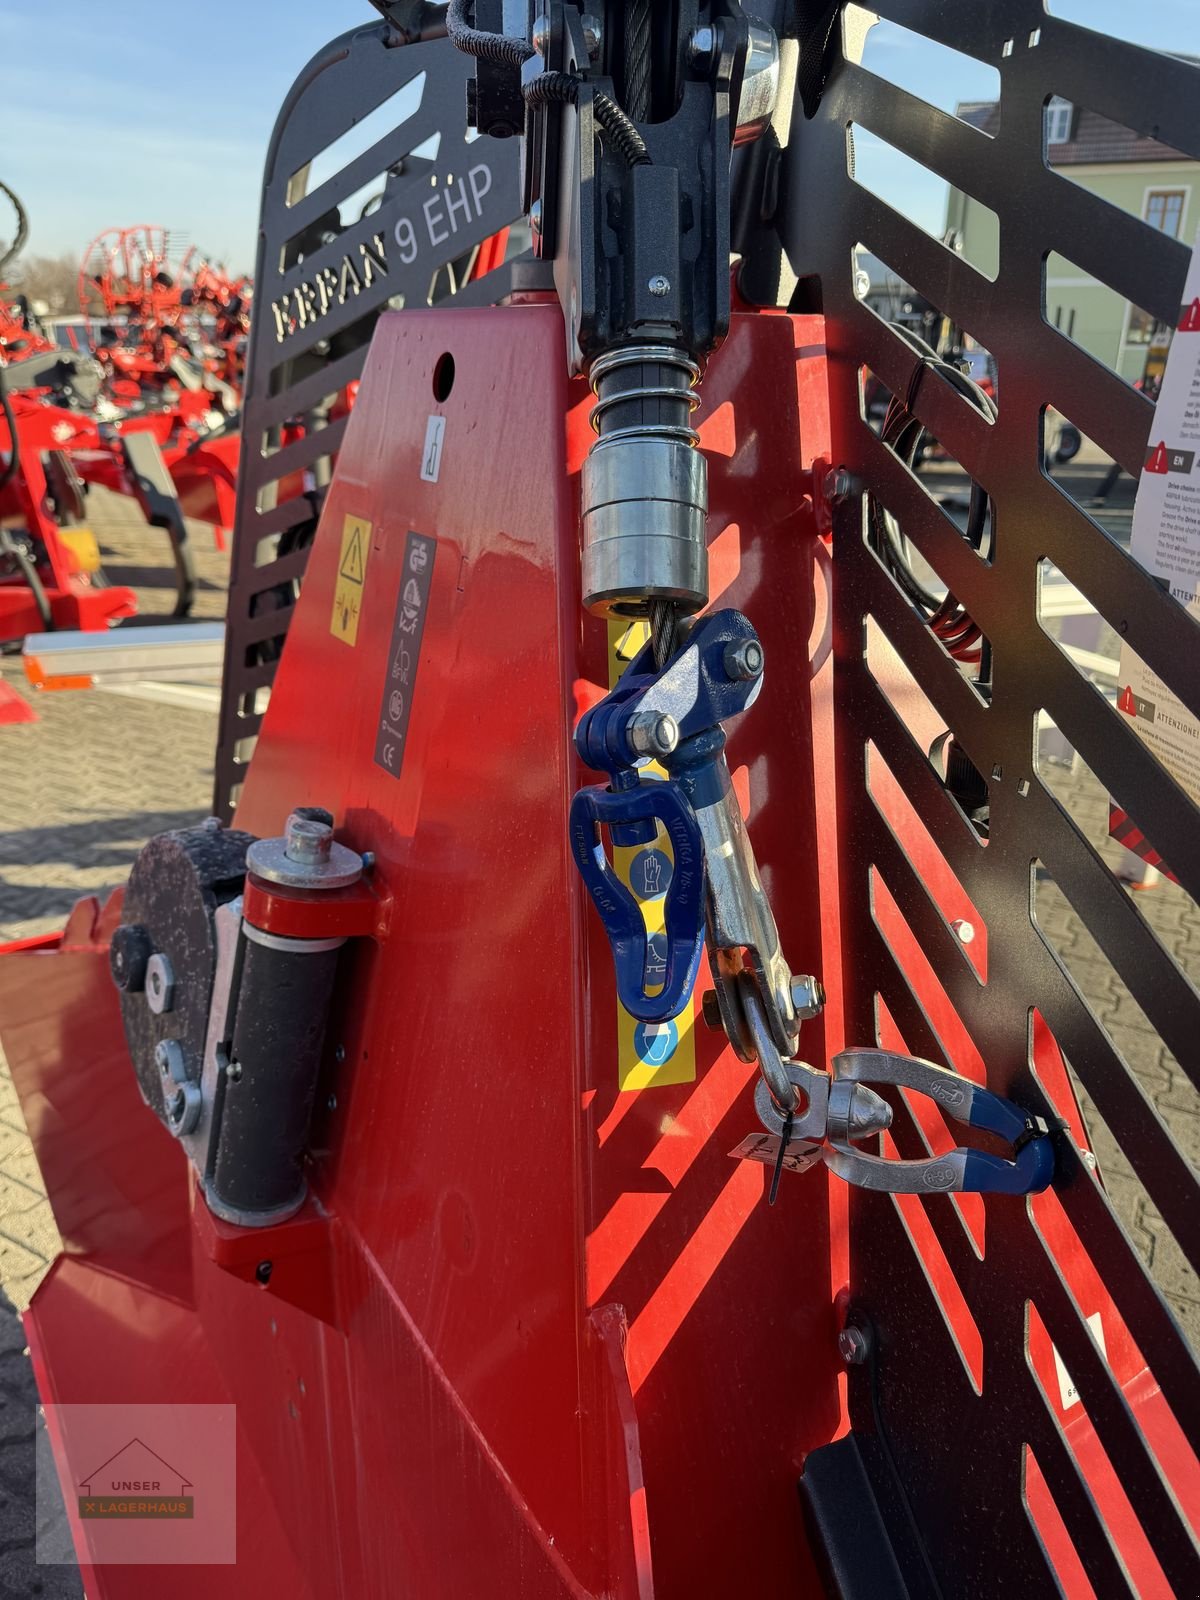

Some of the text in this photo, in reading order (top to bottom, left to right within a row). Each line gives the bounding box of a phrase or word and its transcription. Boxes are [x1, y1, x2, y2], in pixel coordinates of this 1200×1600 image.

[271, 163, 492, 343] KRPAN 9 EHP
[1173, 455, 1184, 466] EN
[1167, 481, 1180, 490] Drive
[1184, 515, 1197, 524] Drive
[1139, 702, 1146, 712] IT
[1157, 711, 1200, 739] ATTENZIONE!
